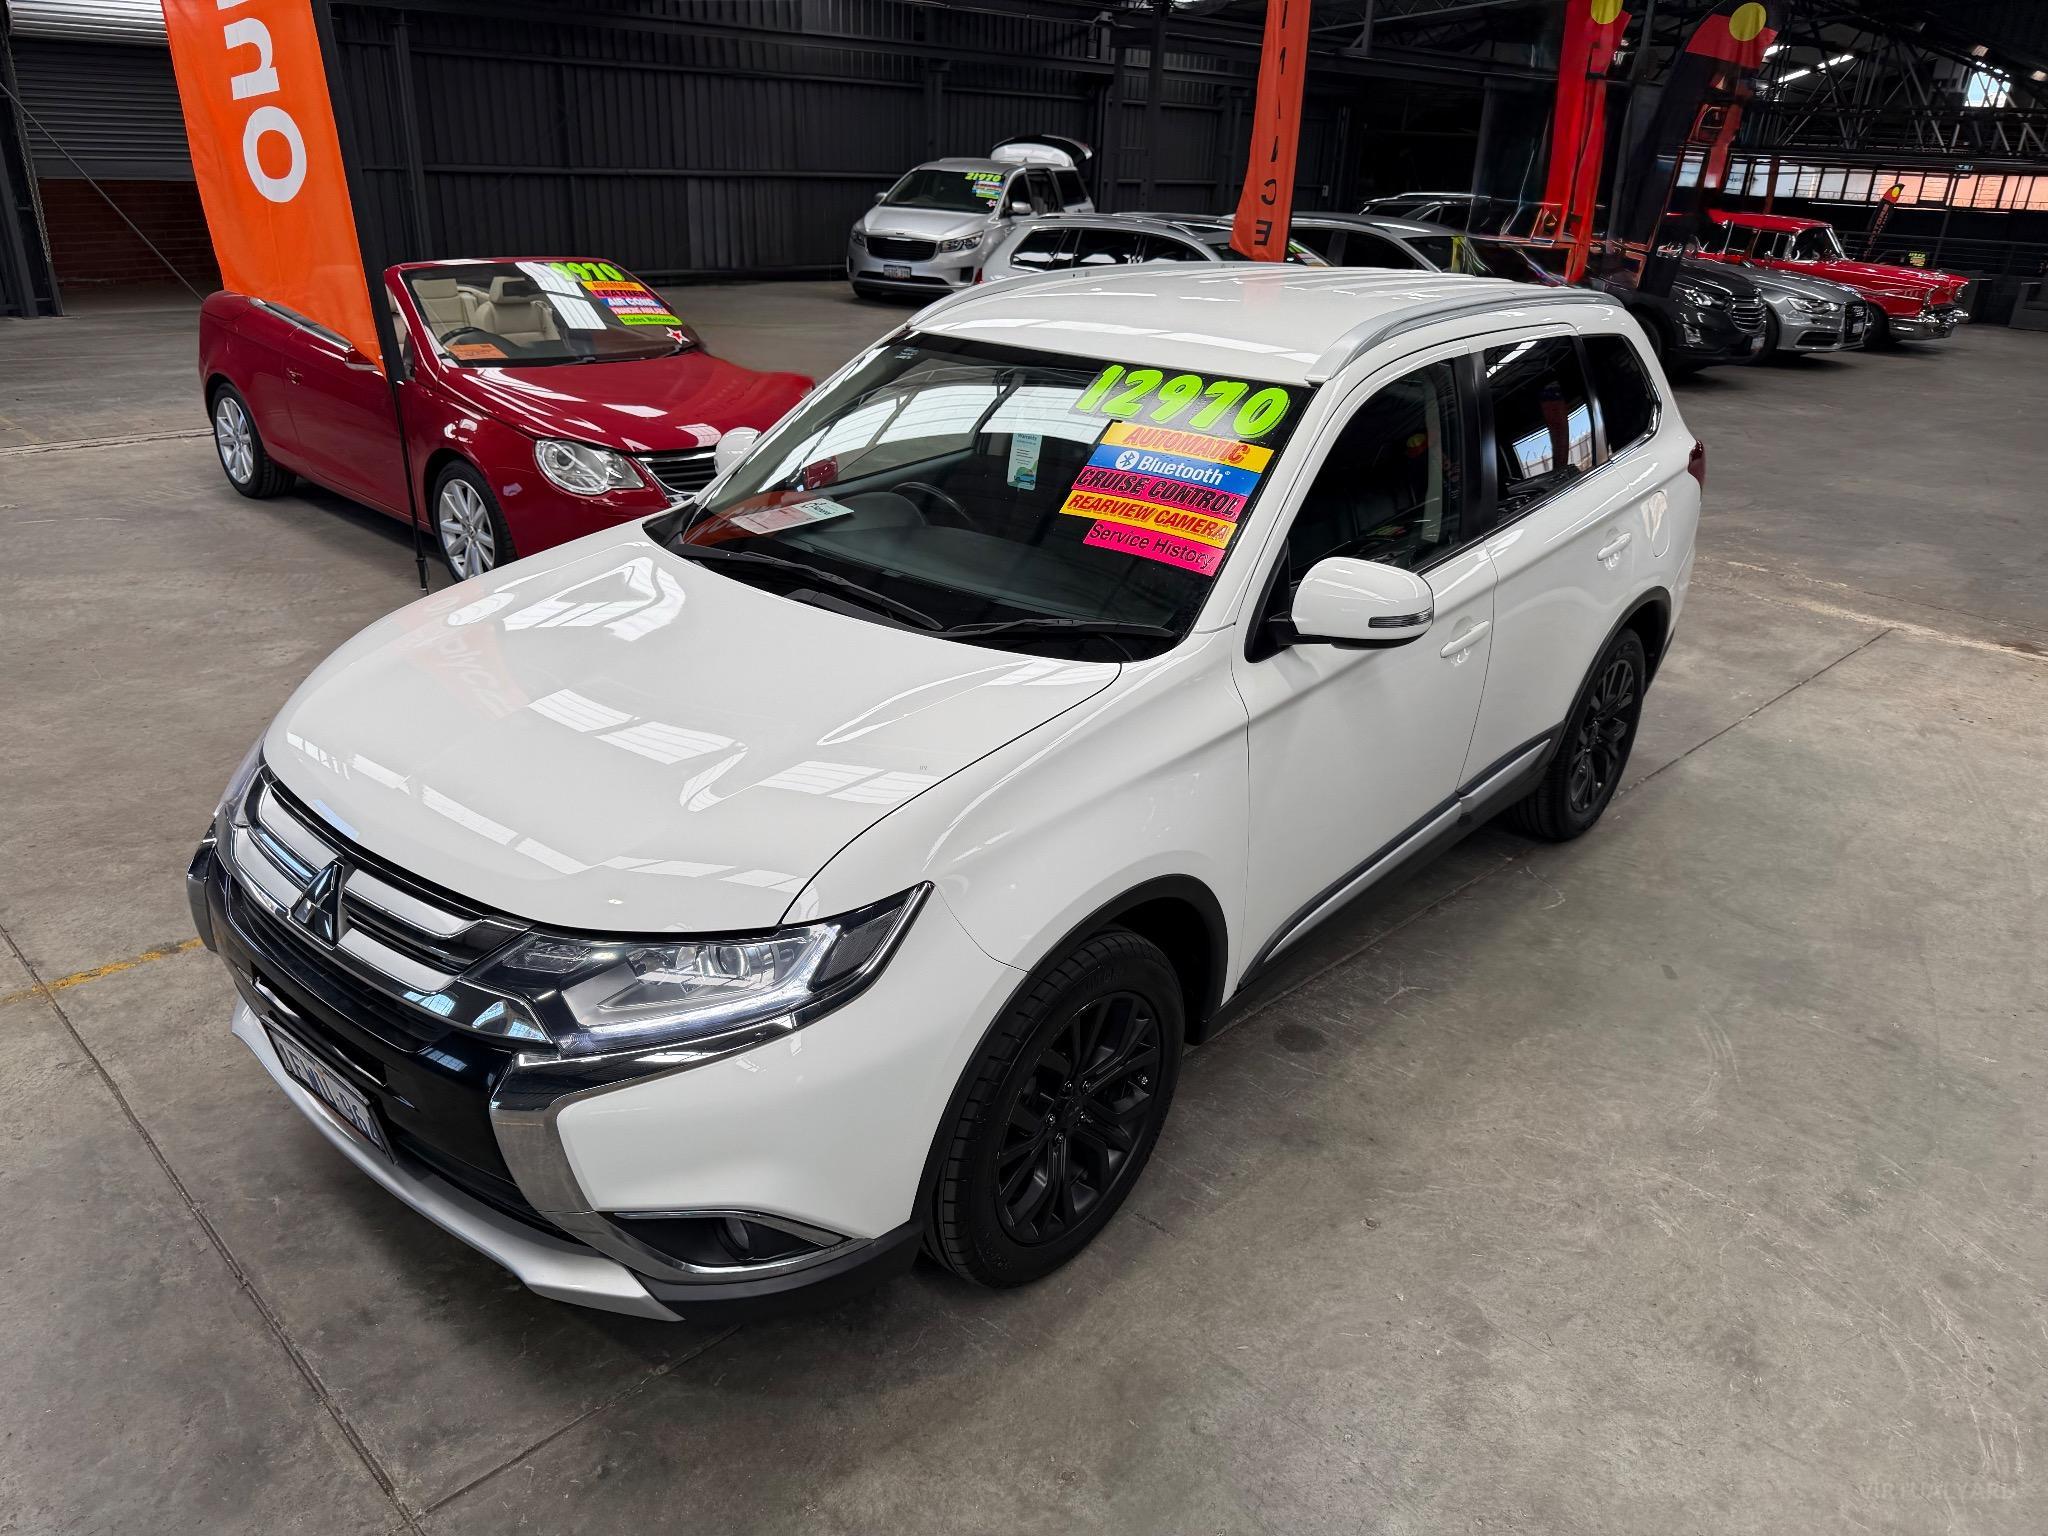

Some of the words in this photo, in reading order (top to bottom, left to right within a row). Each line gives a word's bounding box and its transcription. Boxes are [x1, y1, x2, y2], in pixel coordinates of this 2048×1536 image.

[550, 262, 625, 281] 9970
[596, 289, 651, 299] LEATHER
[607, 298, 626, 307] AIR
[1076, 364, 1291, 439] 12970
[1122, 427, 1250, 463] AUTOMATIC
[1076, 469, 1147, 495] CRUISE
[1149, 481, 1240, 518] CONTROL
[1066, 494, 1157, 521] REARVIEW
[1154, 510, 1230, 540] CAMERA
[1088, 523, 1150, 550] Service
[1153, 538, 1215, 570] History
